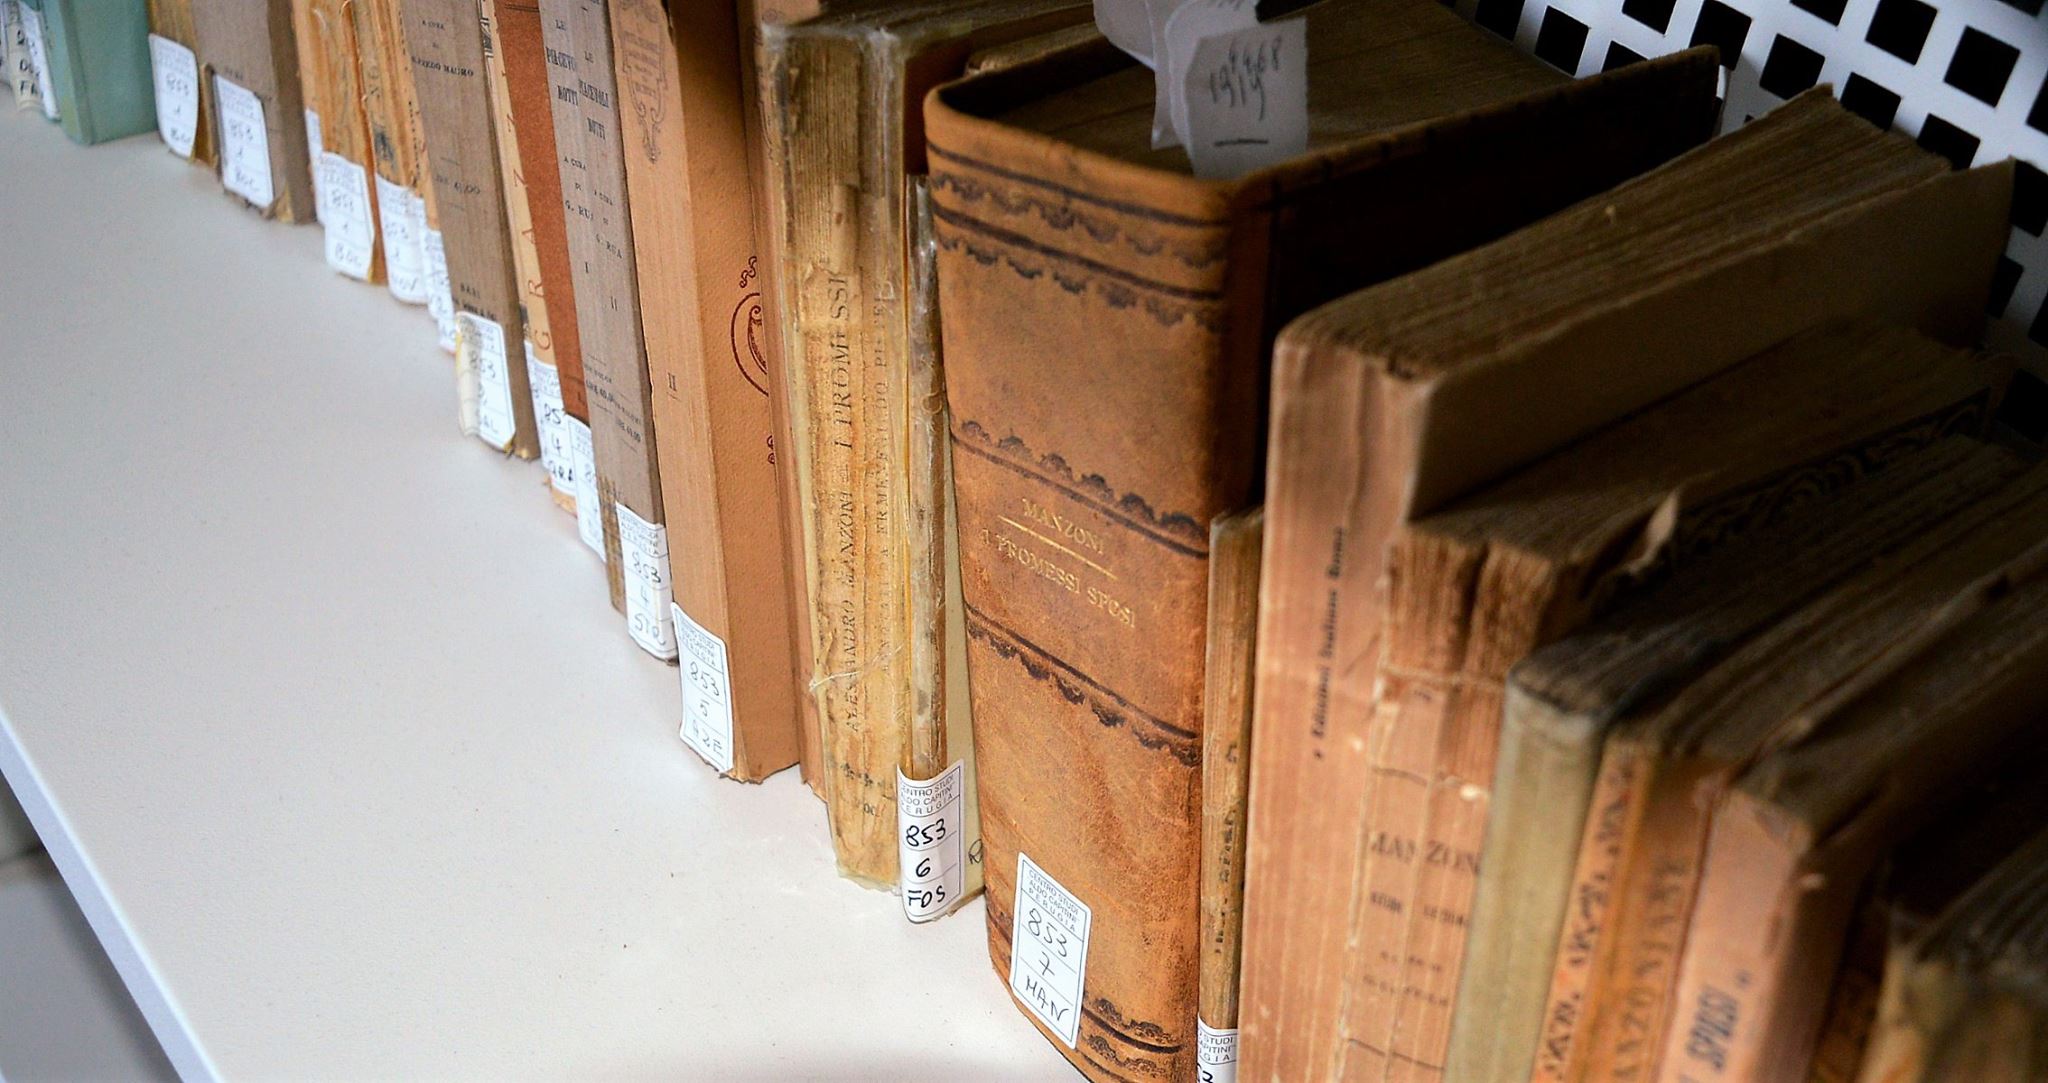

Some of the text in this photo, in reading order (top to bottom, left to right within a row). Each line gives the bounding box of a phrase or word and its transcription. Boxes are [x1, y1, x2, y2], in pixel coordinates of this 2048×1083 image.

[555, 19, 566, 31] LE
[584, 50, 594, 63] LE
[557, 85, 578, 106] NOTTI
[1022, 498, 1104, 555] MANZONI
[996, 534, 1081, 595] PROMESSI
[1087, 586, 1136, 628] SPOSI
[690, 661, 720, 697] 853
[906, 818, 946, 847] 853
[916, 857, 931, 878] 6
[1029, 869, 1079, 916] CENTRO STUDI
[1029, 879, 1079, 925] ALDO CAPITINI
[1029, 887, 1077, 933] PERUGIA
[1027, 907, 1068, 958] 853
[1039, 950, 1055, 976] 7
